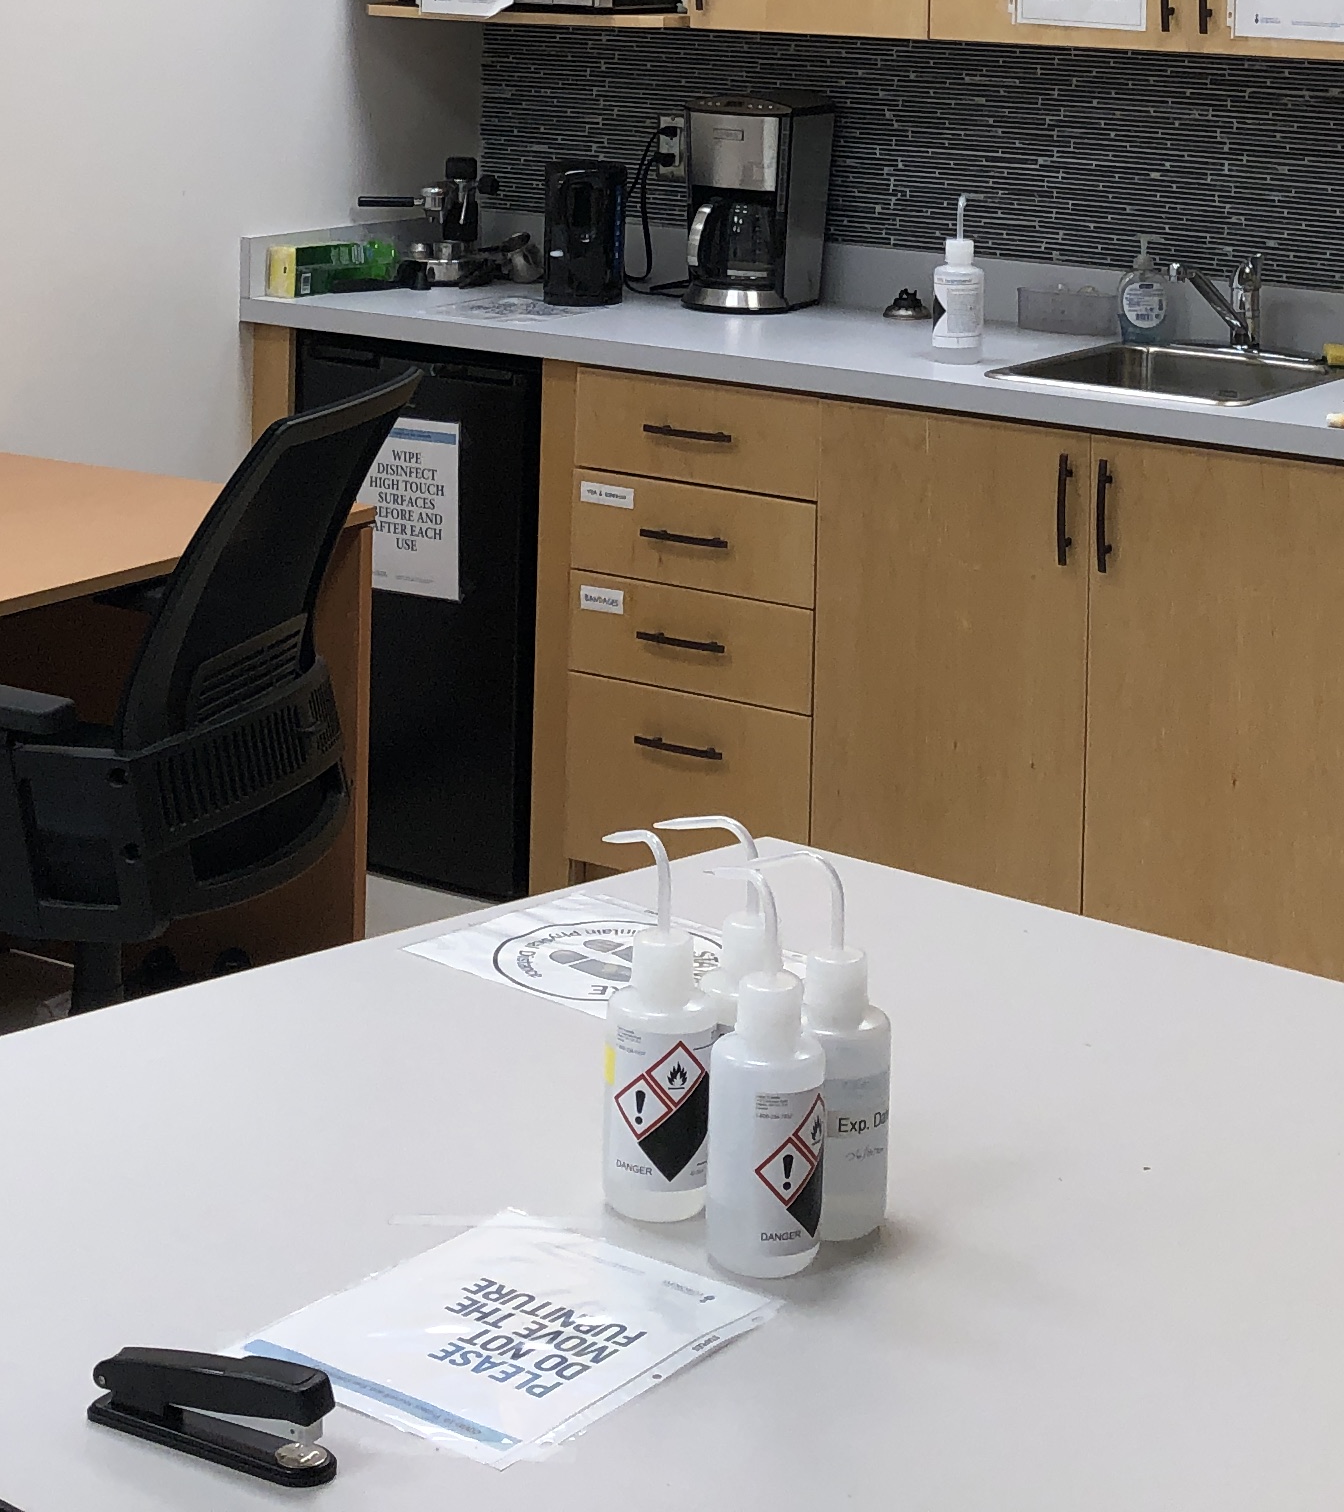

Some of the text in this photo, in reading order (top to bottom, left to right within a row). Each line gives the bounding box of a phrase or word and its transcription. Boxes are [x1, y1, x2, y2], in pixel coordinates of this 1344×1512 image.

[392, 450, 421, 464] WIPE
[377, 463, 437, 481] DISINFECT
[370, 476, 444, 496] HIGH TOUCH
[378, 492, 435, 510] SURFACES
[417, 512, 442, 525] AND
[373, 521, 442, 540] AFTER EACH
[396, 538, 417, 551] USE
[585, 594, 618, 606] BANDAGES
[839, 1118, 869, 1134] Exp.
[616, 1159, 653, 1175] DANGER
[761, 1231, 801, 1241] DANGER
[445, 1296, 619, 1364] MOVE THE
[457, 1329, 592, 1381] DO NOT
[427, 1342, 563, 1398] PLEASE
